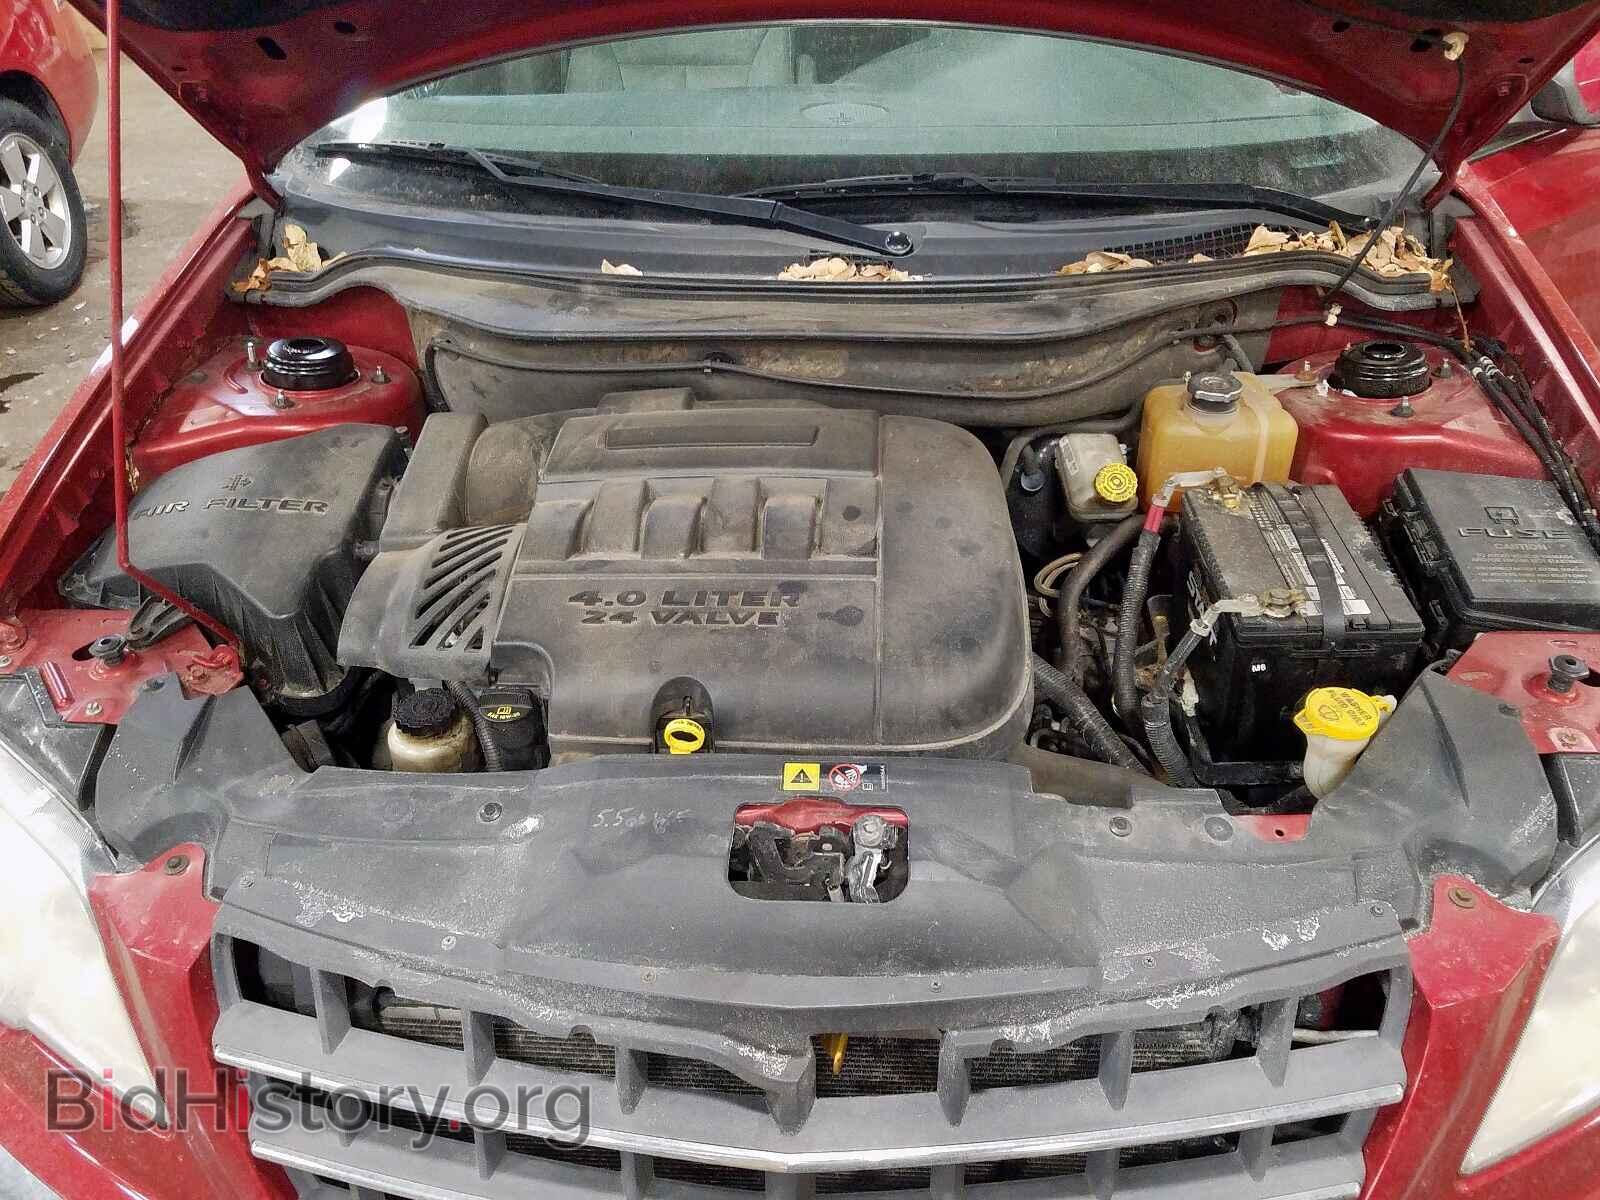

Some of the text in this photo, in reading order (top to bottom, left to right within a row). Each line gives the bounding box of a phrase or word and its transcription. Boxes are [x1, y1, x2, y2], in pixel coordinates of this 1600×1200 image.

[133, 497, 329, 520] AIR FILTER
[1457, 527, 1571, 540] FUSE
[567, 590, 800, 608] 4.0 LITER
[580, 610, 780, 627] 24 VALVE
